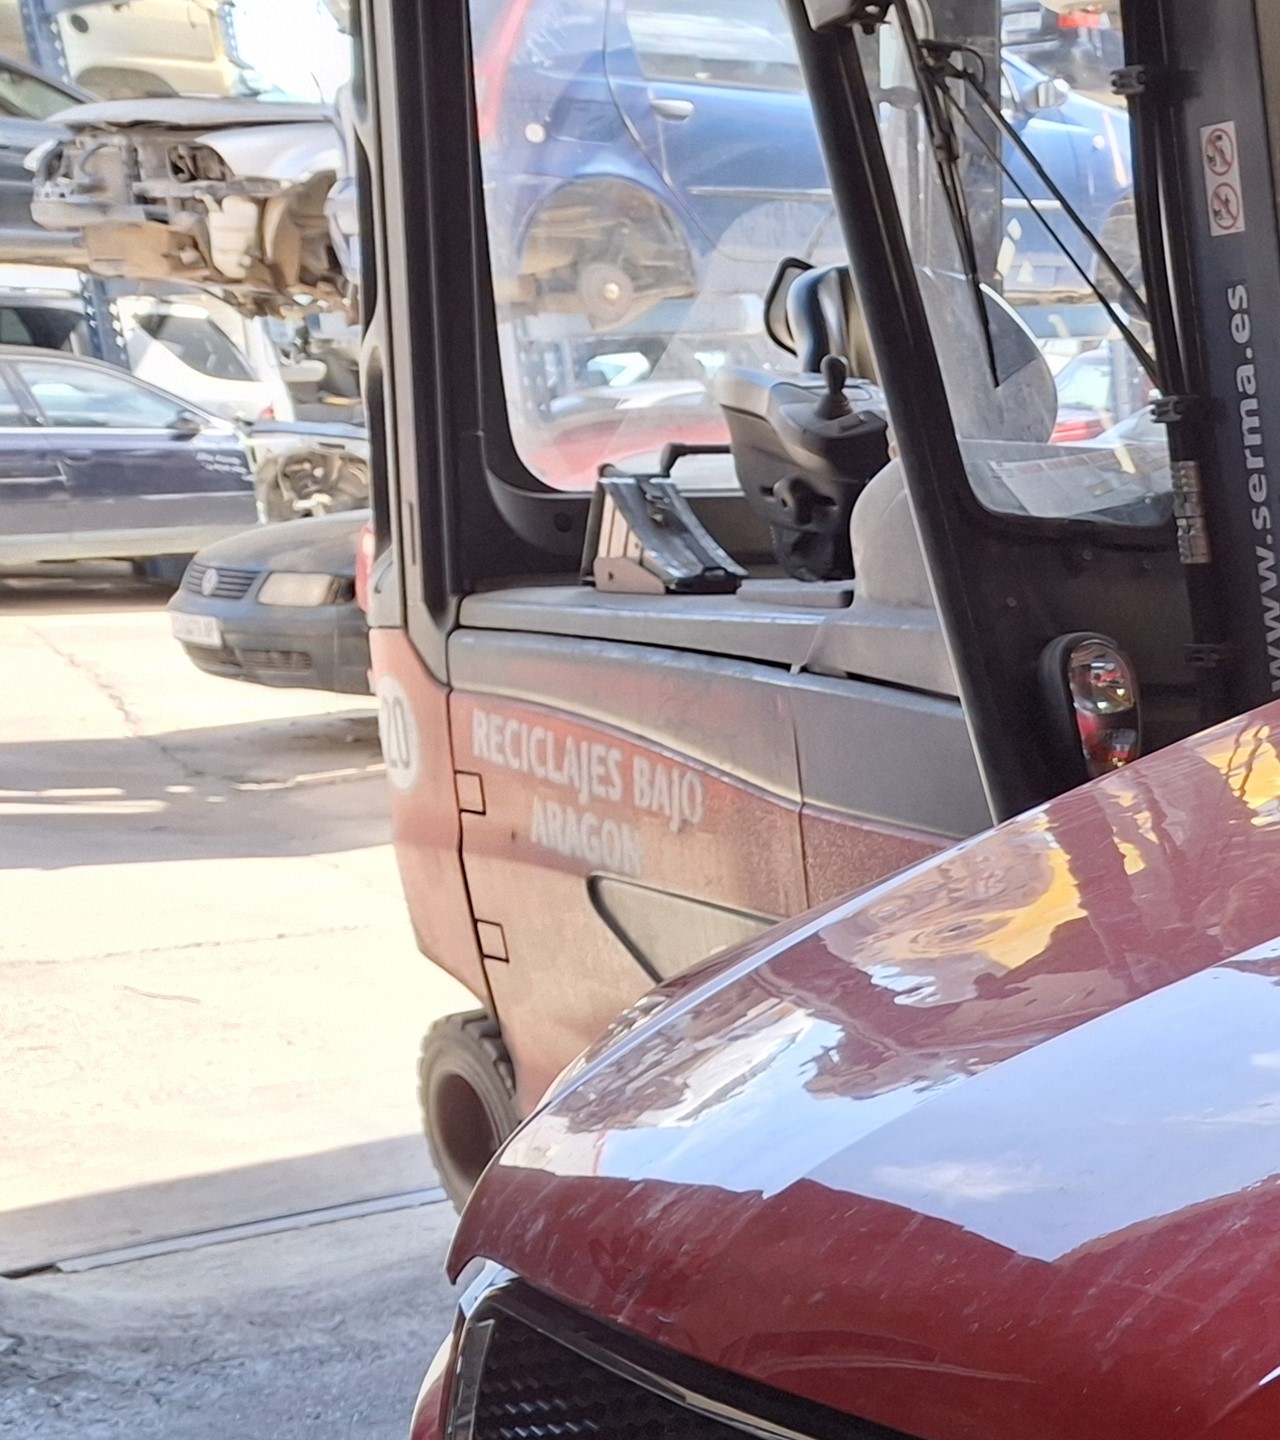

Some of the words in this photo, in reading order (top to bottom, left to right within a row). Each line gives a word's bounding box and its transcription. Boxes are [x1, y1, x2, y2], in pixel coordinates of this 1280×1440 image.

[471, 706, 624, 806] RECICLAJES
[631, 754, 705, 833] BAJO
[529, 795, 642, 879] ARAGON
